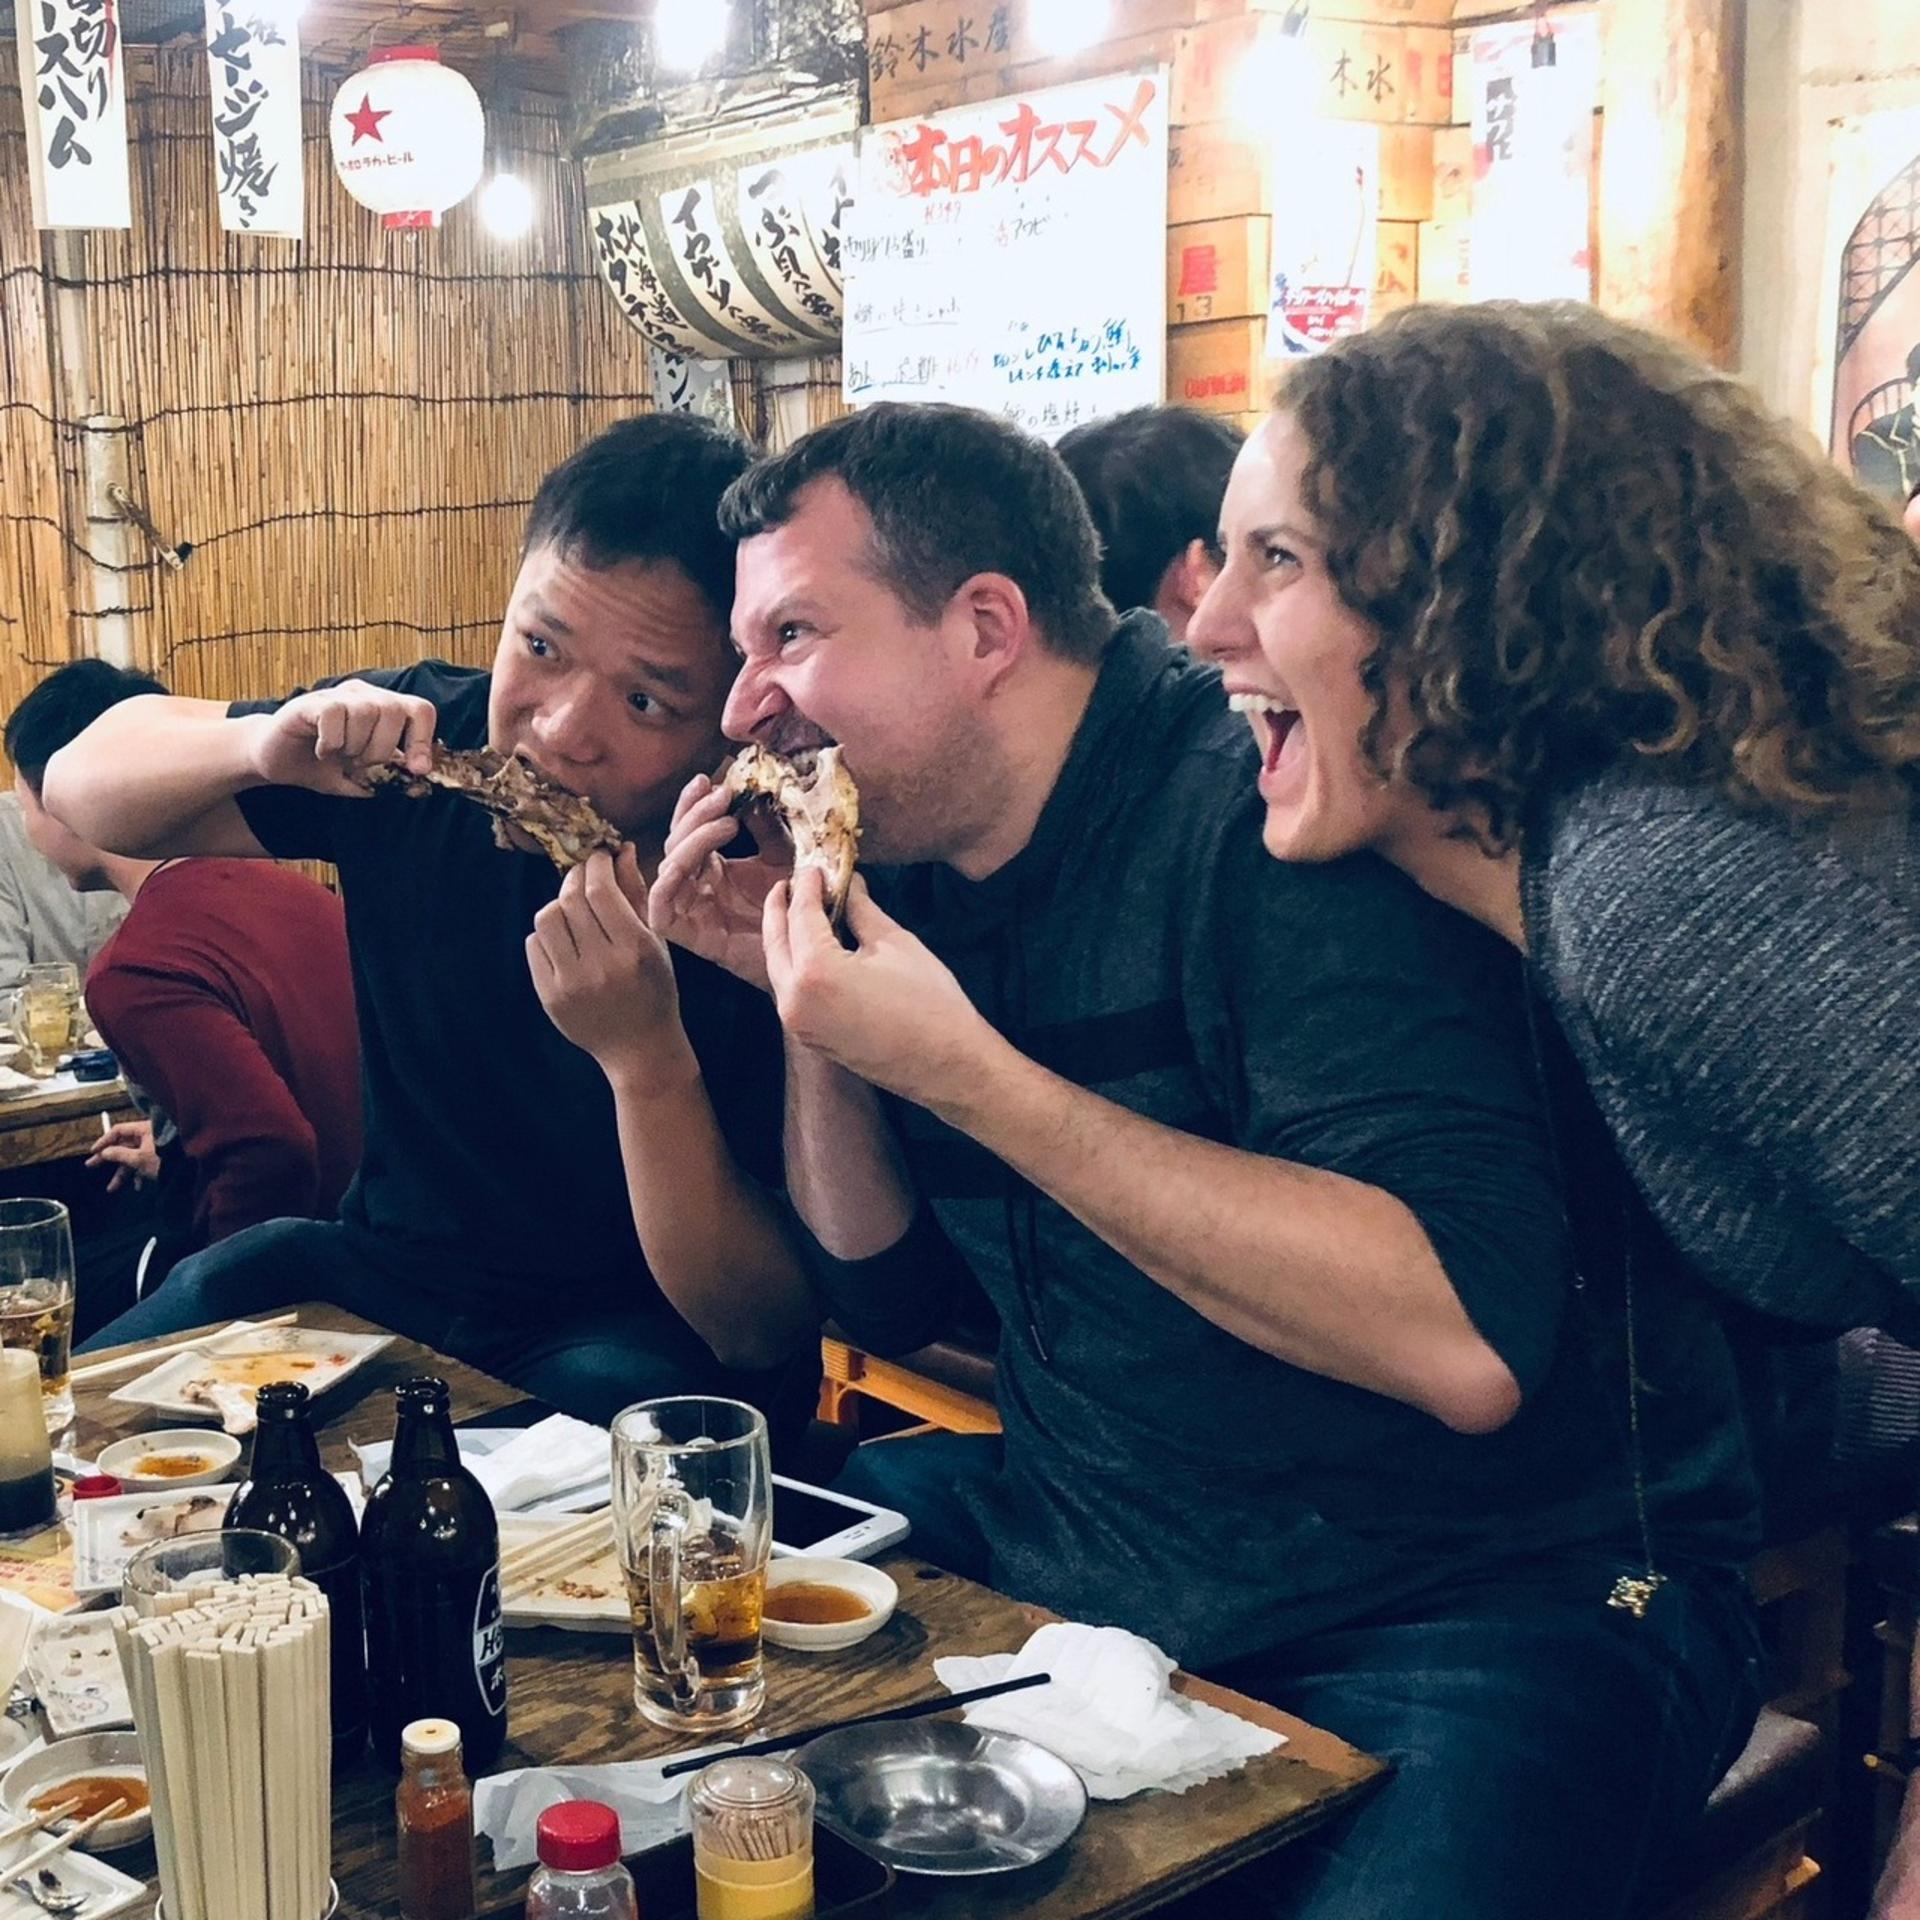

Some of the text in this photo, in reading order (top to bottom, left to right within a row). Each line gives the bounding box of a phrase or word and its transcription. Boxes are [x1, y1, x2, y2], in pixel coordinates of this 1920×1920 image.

[207, 0, 279, 228] セージ焼き
[901, 79, 1157, 198] 本日のオススメ
